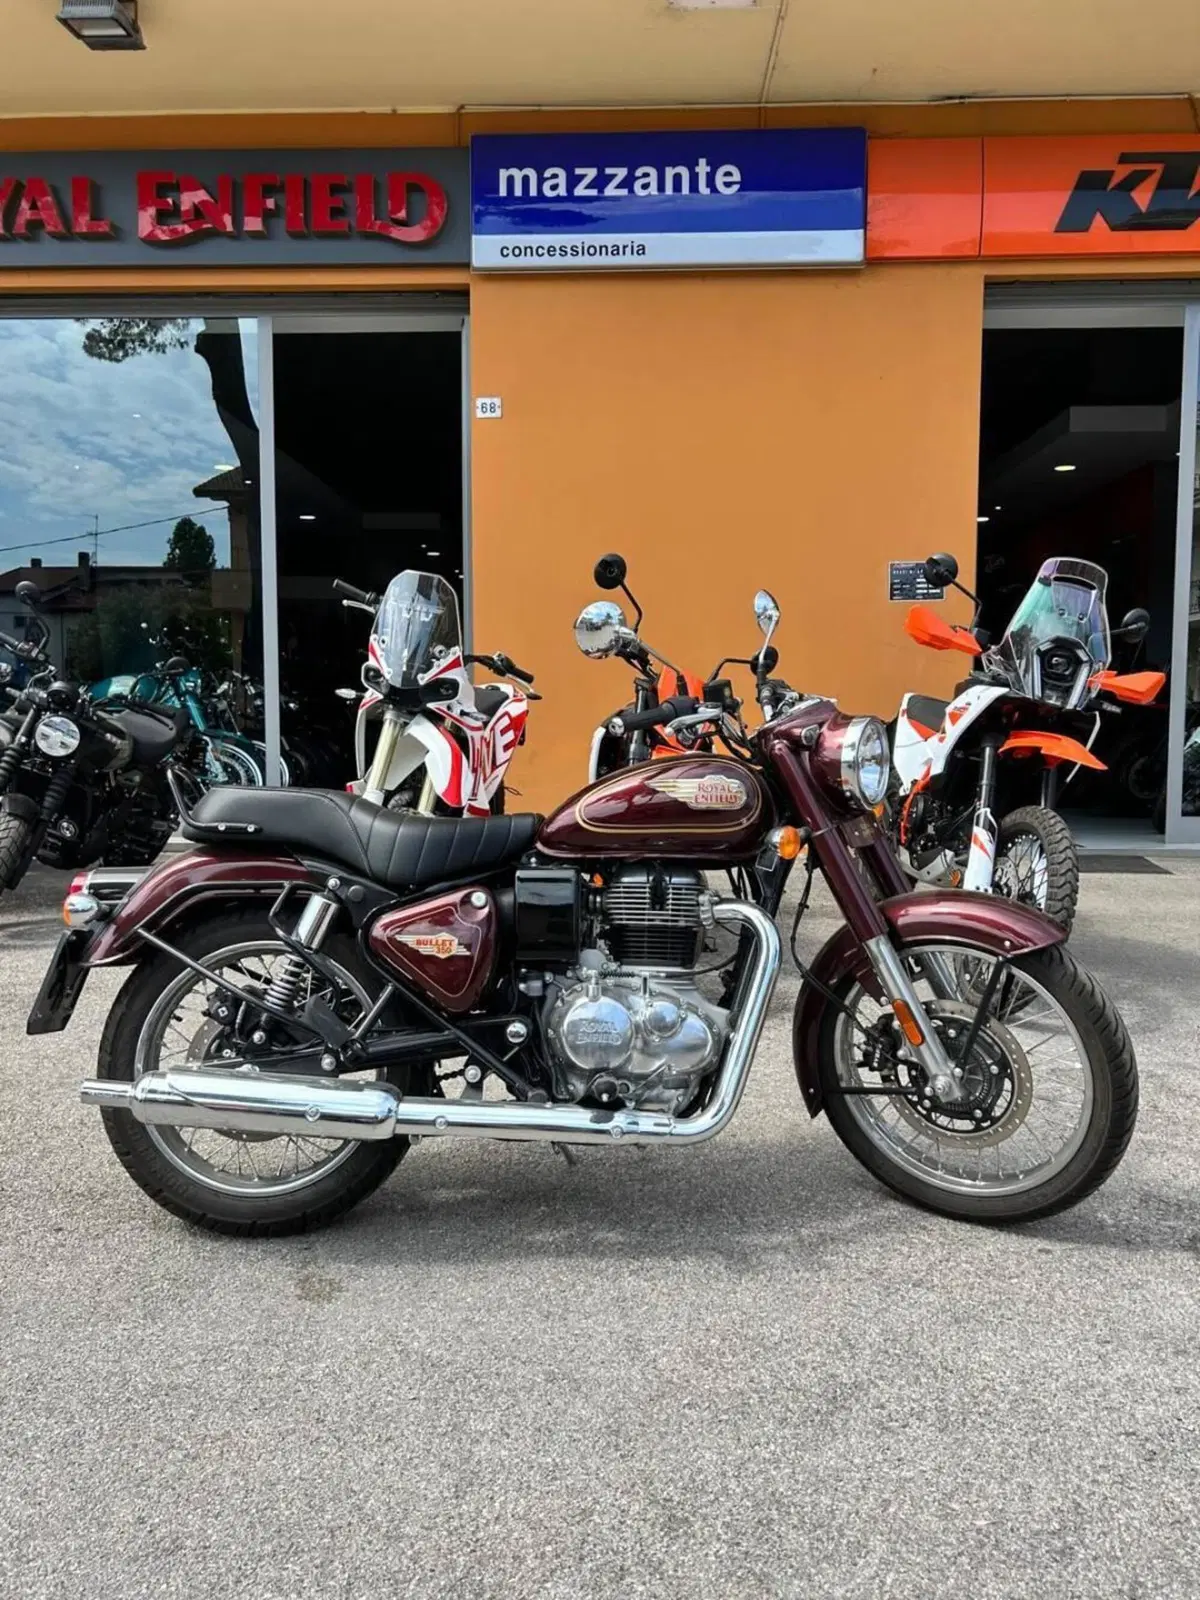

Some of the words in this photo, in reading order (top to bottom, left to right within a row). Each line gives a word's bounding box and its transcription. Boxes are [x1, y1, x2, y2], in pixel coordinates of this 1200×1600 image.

[499, 158, 742, 197] mazzante
[1053, 151, 1200, 233] KT
[136, 170, 447, 244] ENFIELD
[500, 241, 647, 258] concessionaria
[480, 402, 496, 413] 68
[697, 783, 733, 792] ROYAL
[694, 793, 738, 804] ENFIELD
[415, 938, 453, 946] BULLET
